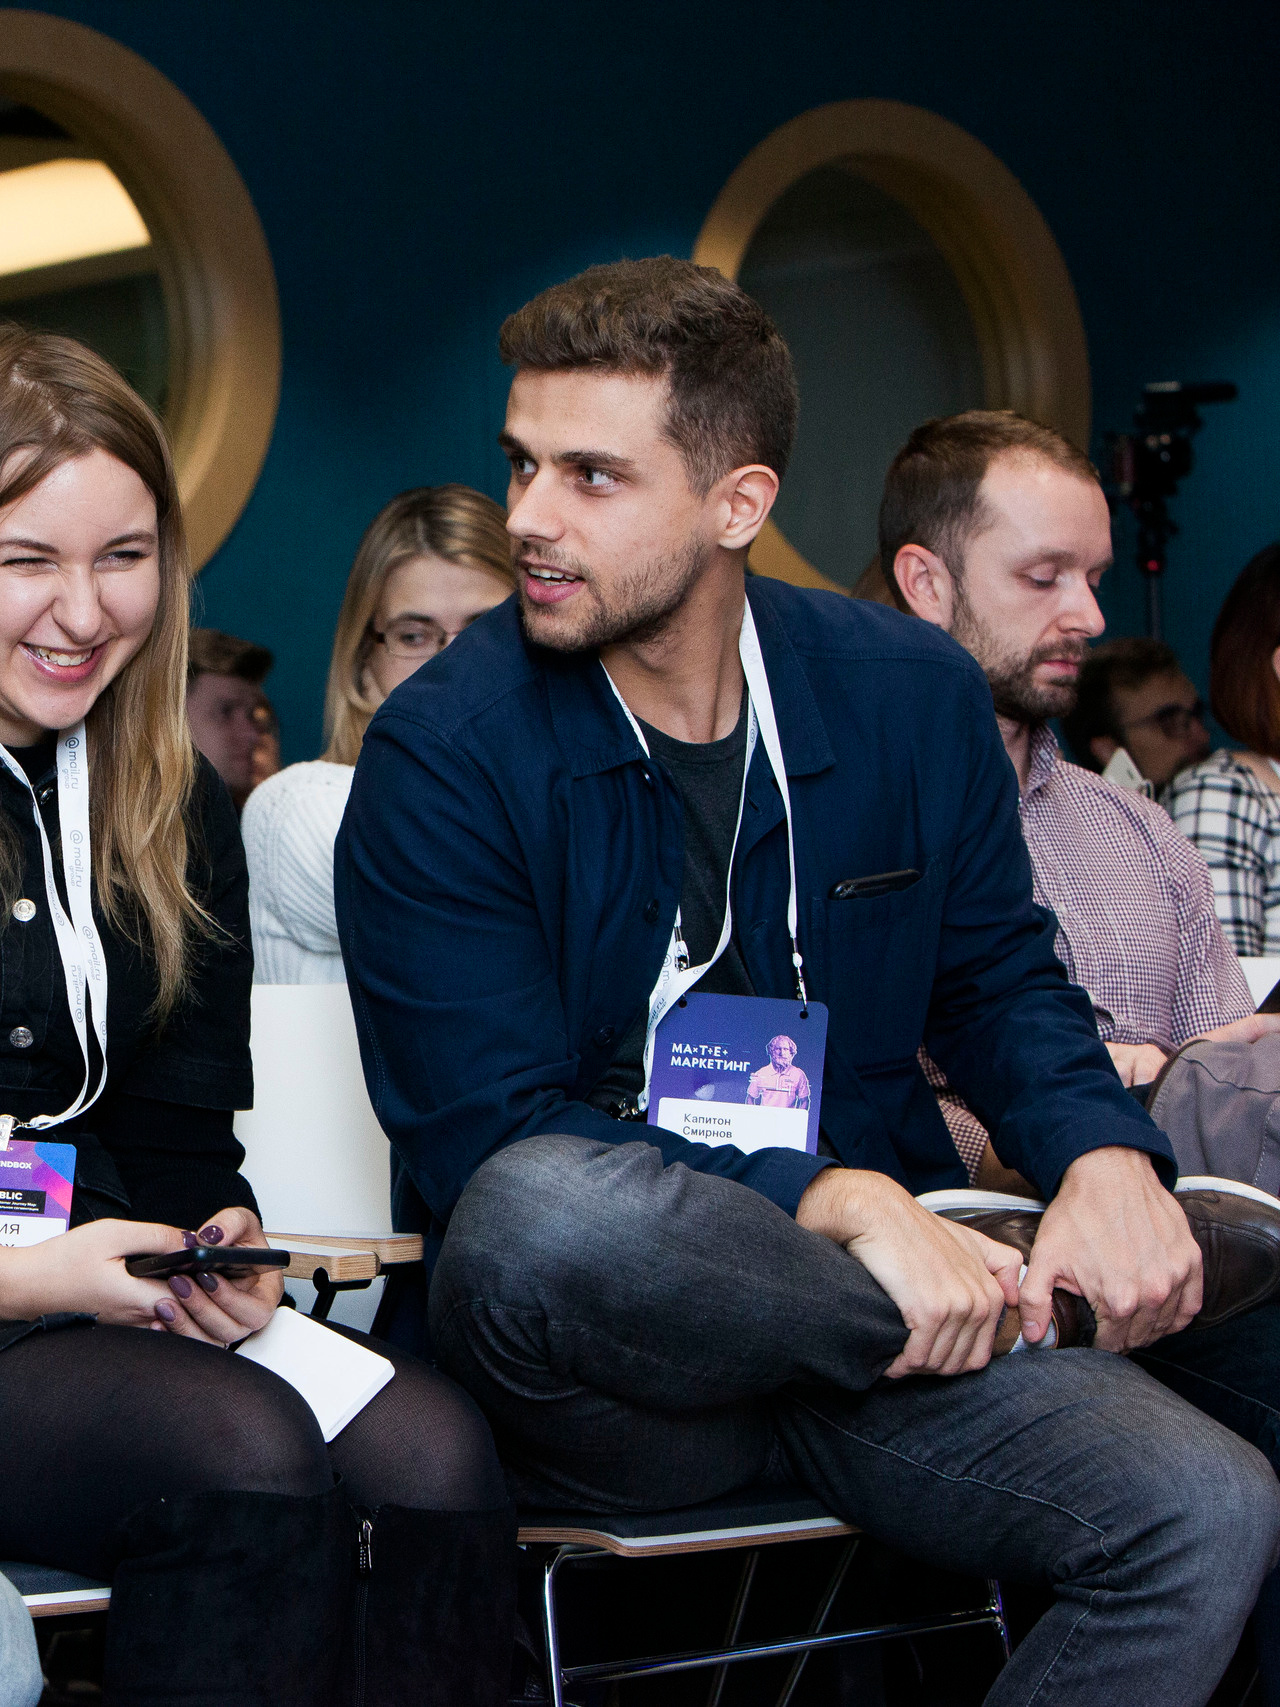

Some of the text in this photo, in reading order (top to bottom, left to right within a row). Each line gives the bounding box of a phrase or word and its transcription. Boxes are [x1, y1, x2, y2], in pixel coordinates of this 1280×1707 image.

[671, 1056, 751, 1073] МАРКЕТИНГ
[684, 1113, 731, 1126] Капитон
[682, 1126, 733, 1139] Смирнов
